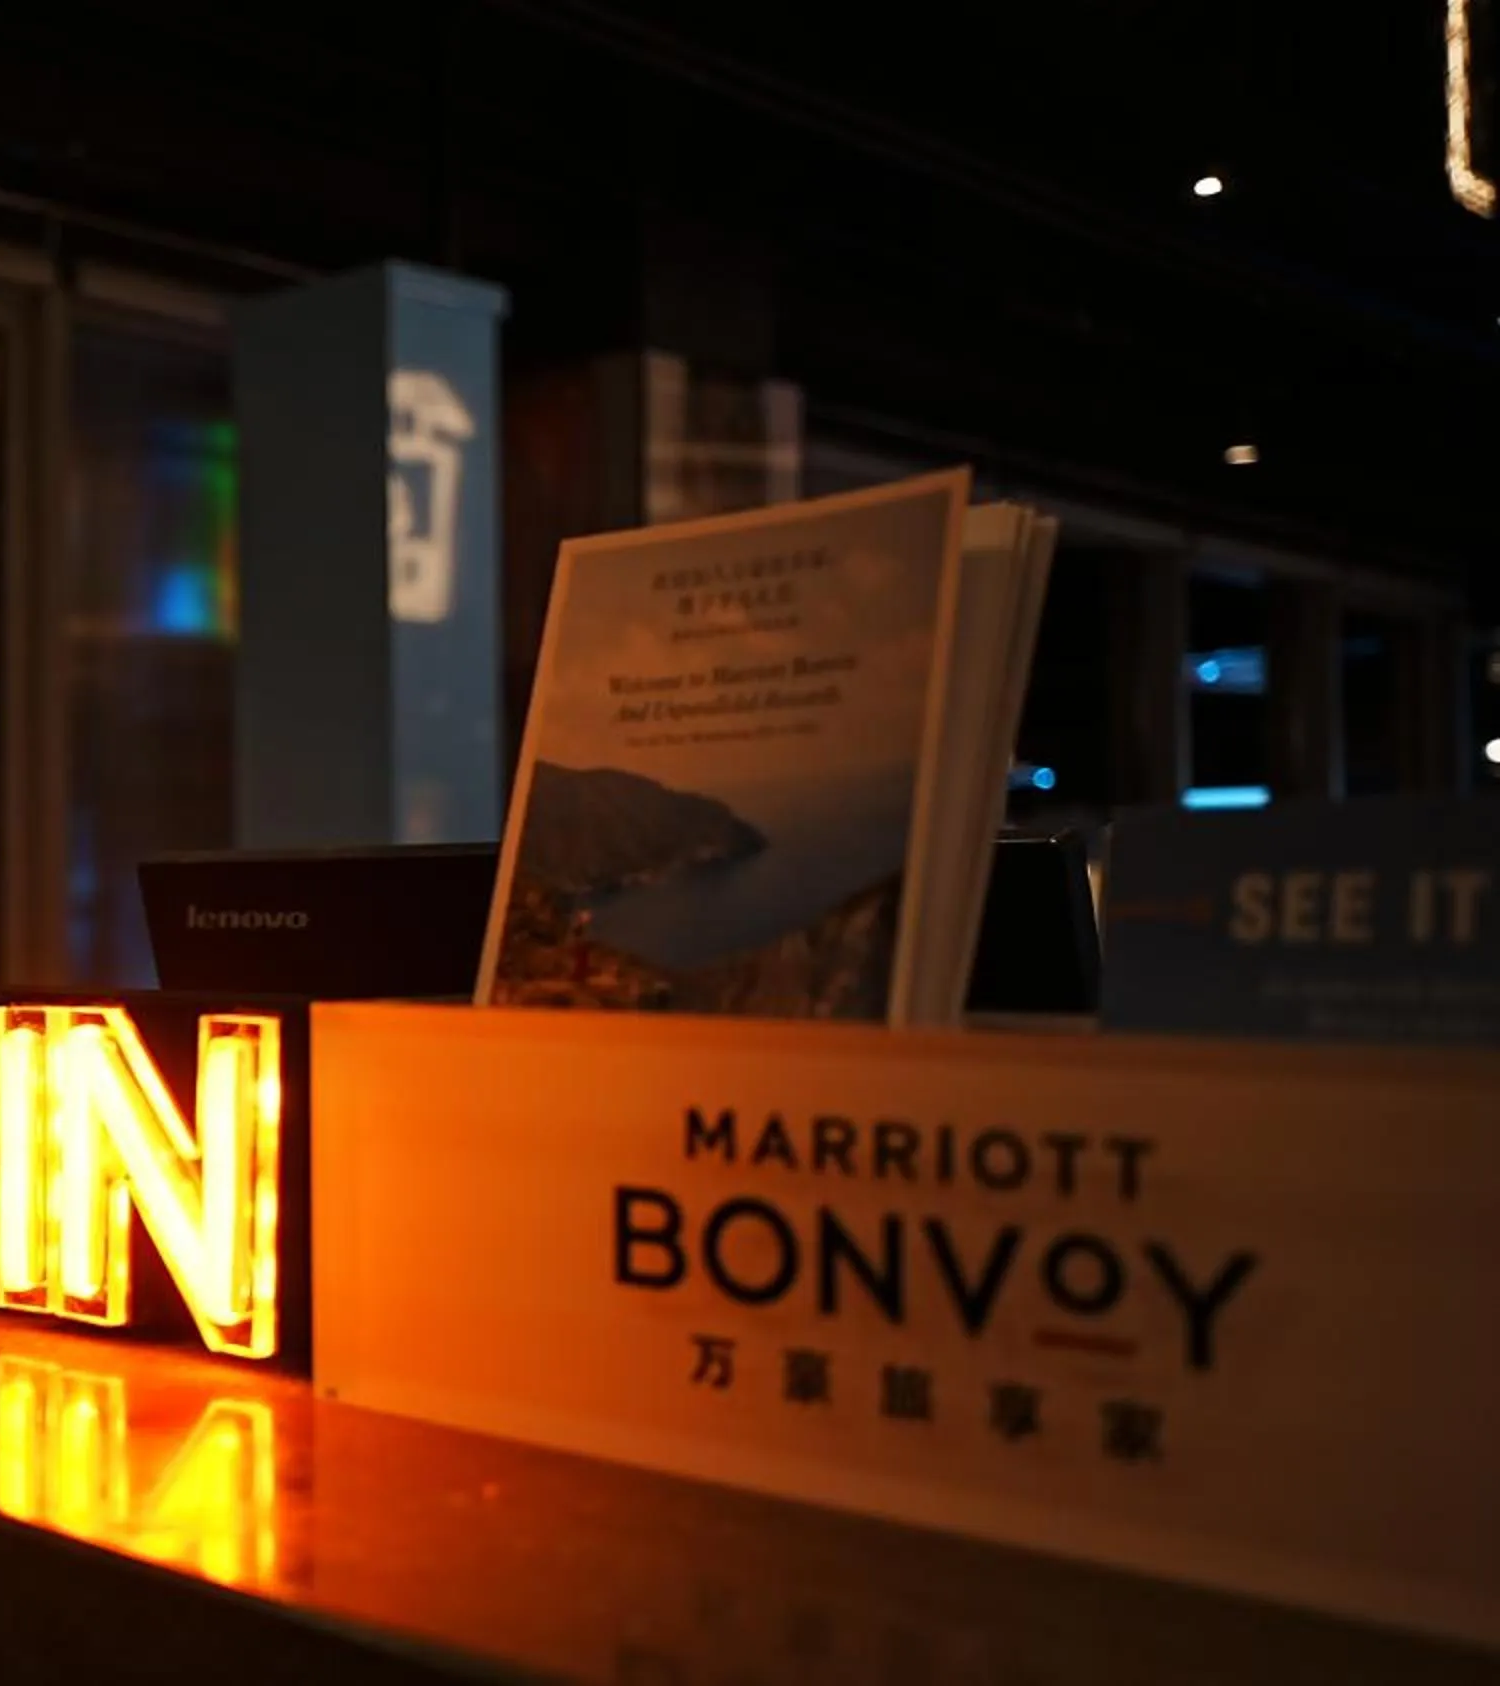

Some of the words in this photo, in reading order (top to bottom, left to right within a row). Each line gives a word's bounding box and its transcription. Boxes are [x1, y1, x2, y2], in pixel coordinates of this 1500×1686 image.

[185, 903, 311, 931] lenovo
[1228, 868, 1379, 948] SEE
[1407, 868, 1494, 948] IT
[685, 1106, 1156, 1201] MARRIOTT
[613, 1185, 1258, 1372] BONVOY
